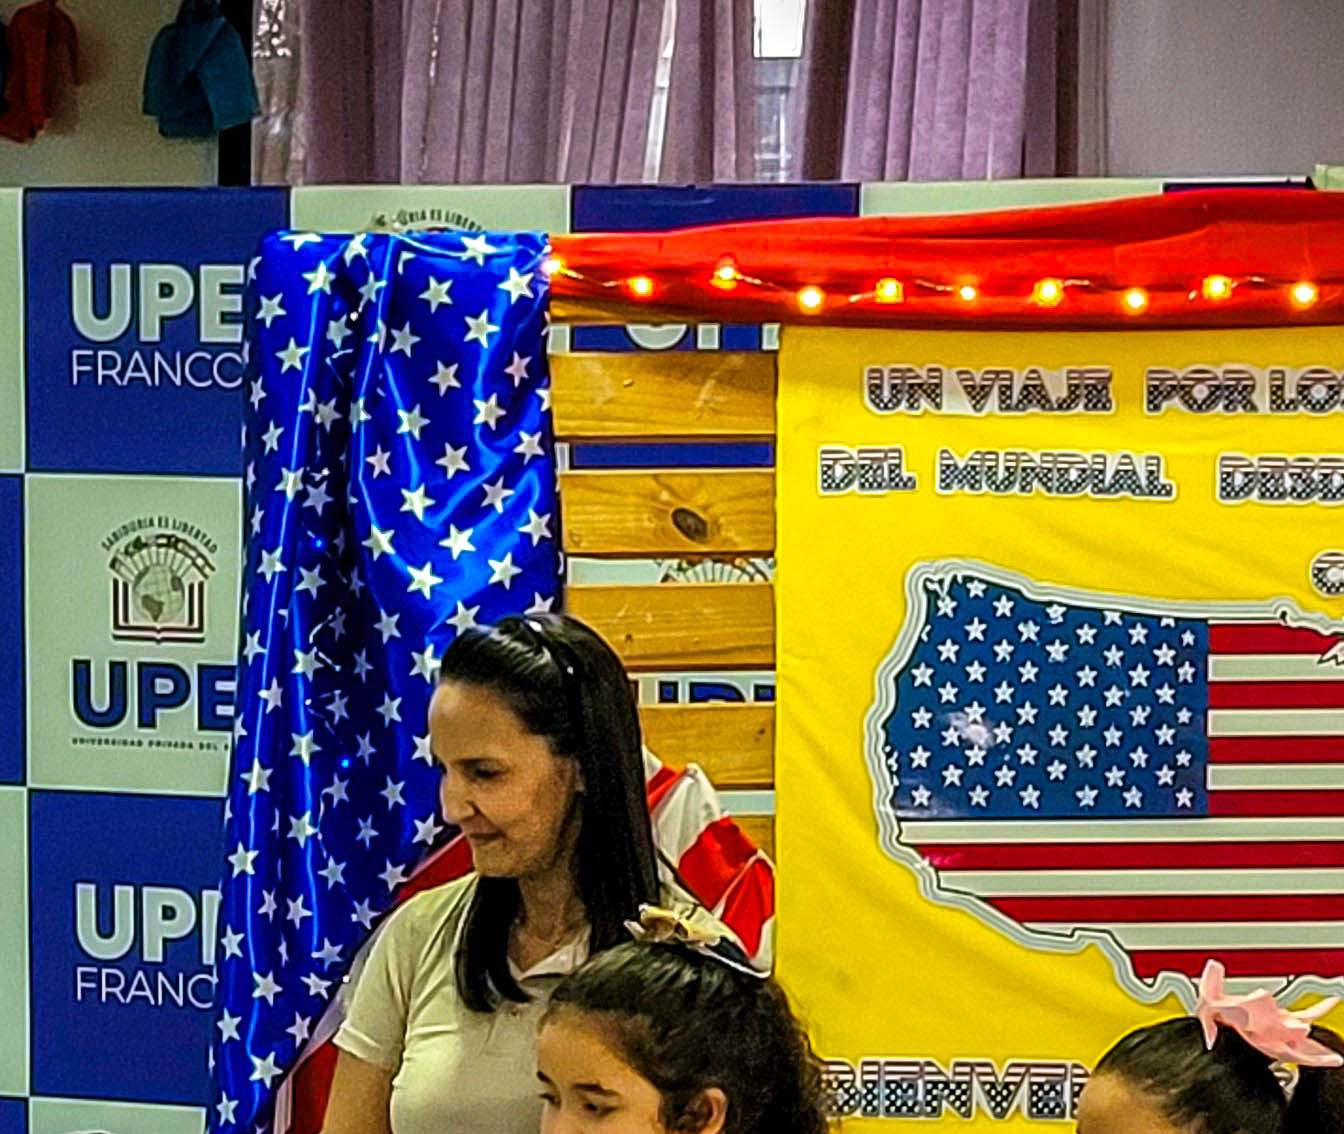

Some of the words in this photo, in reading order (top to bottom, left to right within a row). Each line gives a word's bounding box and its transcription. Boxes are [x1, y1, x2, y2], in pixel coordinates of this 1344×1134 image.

[71, 263, 245, 344] UPE
[71, 349, 244, 388] FRANCO
[866, 366, 944, 412] UN
[956, 367, 1114, 414] VIAJE
[1145, 367, 1260, 414] POR
[819, 447, 917, 493] DEL
[938, 448, 1174, 499] MUNDIAL
[72, 659, 237, 731] UPE
[76, 967, 216, 1009] FRANC
